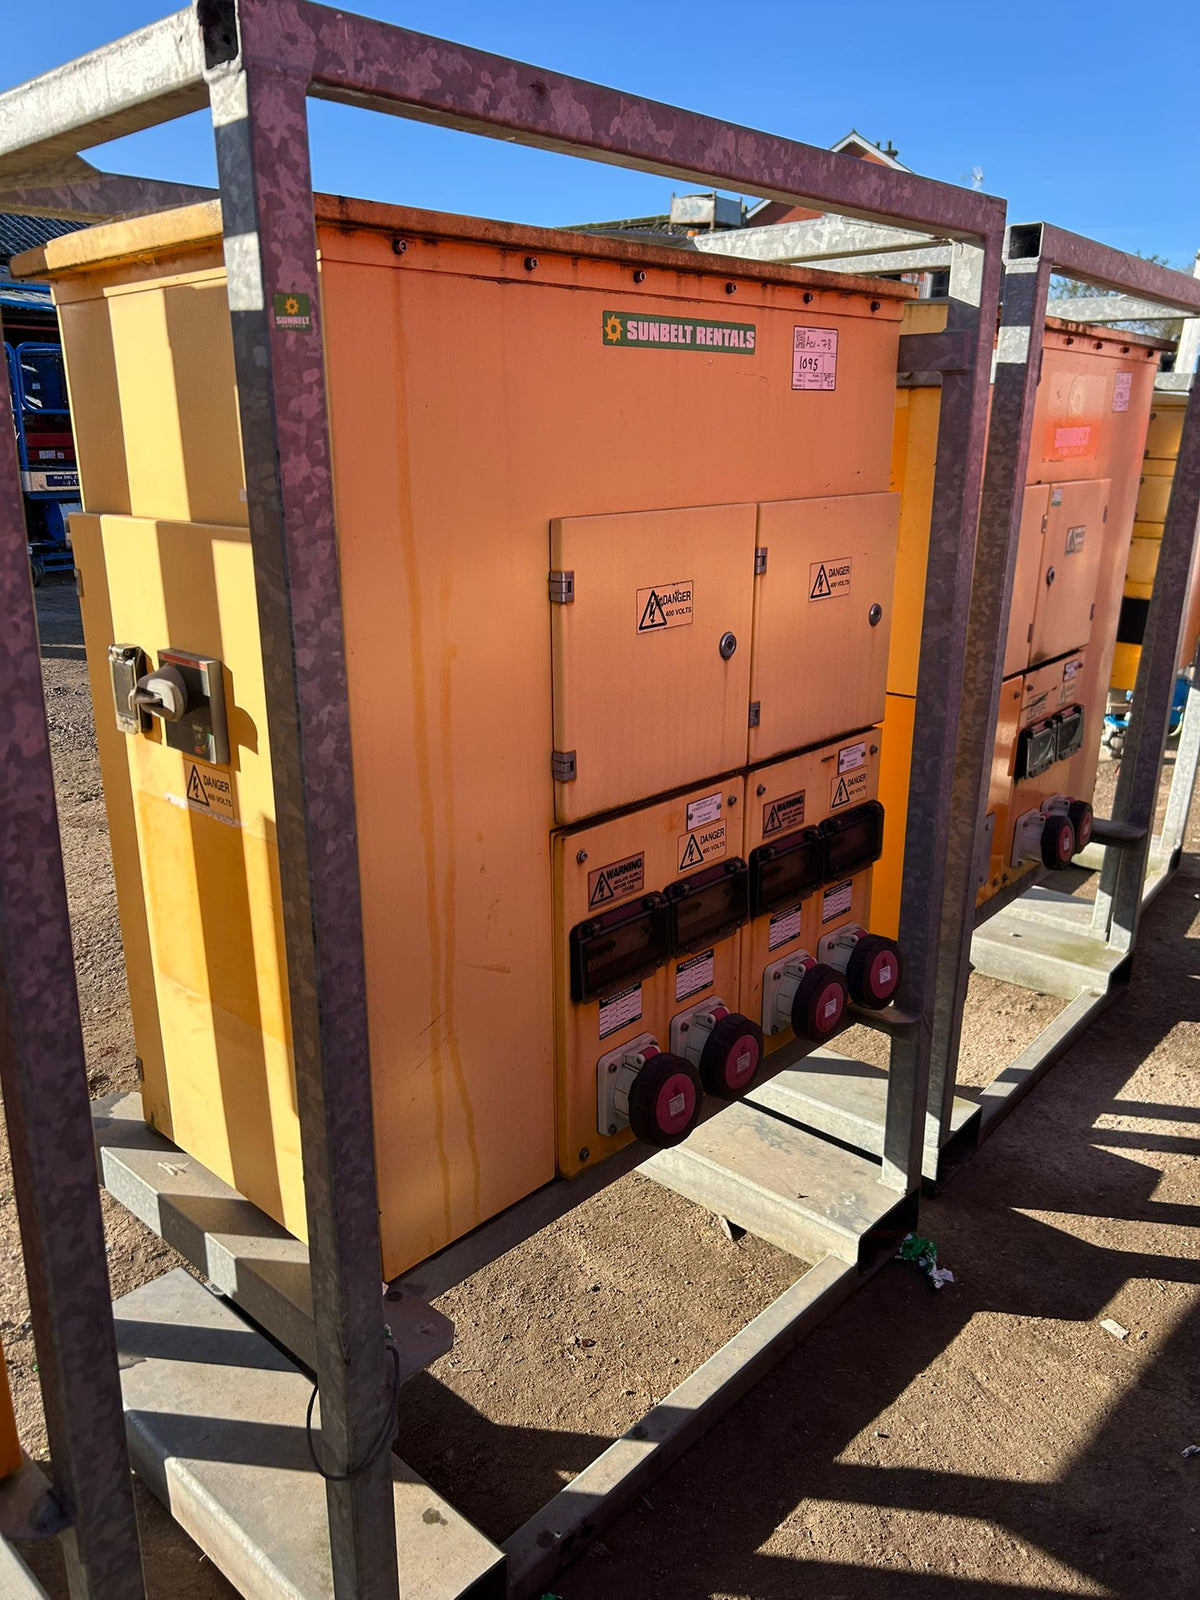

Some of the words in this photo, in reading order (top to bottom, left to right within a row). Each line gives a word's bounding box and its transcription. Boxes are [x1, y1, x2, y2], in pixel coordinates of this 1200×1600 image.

[276, 316, 310, 325] SUNBELT
[626, 320, 693, 344] SUNBELT
[696, 326, 755, 349] RENTALS
[799, 355, 819, 372] 1095
[828, 565, 850, 578] DANGER
[662, 590, 691, 605] DANGER
[675, 606, 692, 615] VOLTS
[203, 775, 229, 793] DANGER
[847, 773, 867, 787] DANGER
[855, 785, 867, 793] VOLTS
[216, 796, 232, 807] VOLTS
[776, 795, 804, 812] WARNING
[700, 827, 725, 845] DANGER
[710, 841, 725, 850] VOLTS
[606, 858, 642, 881] WARNING
